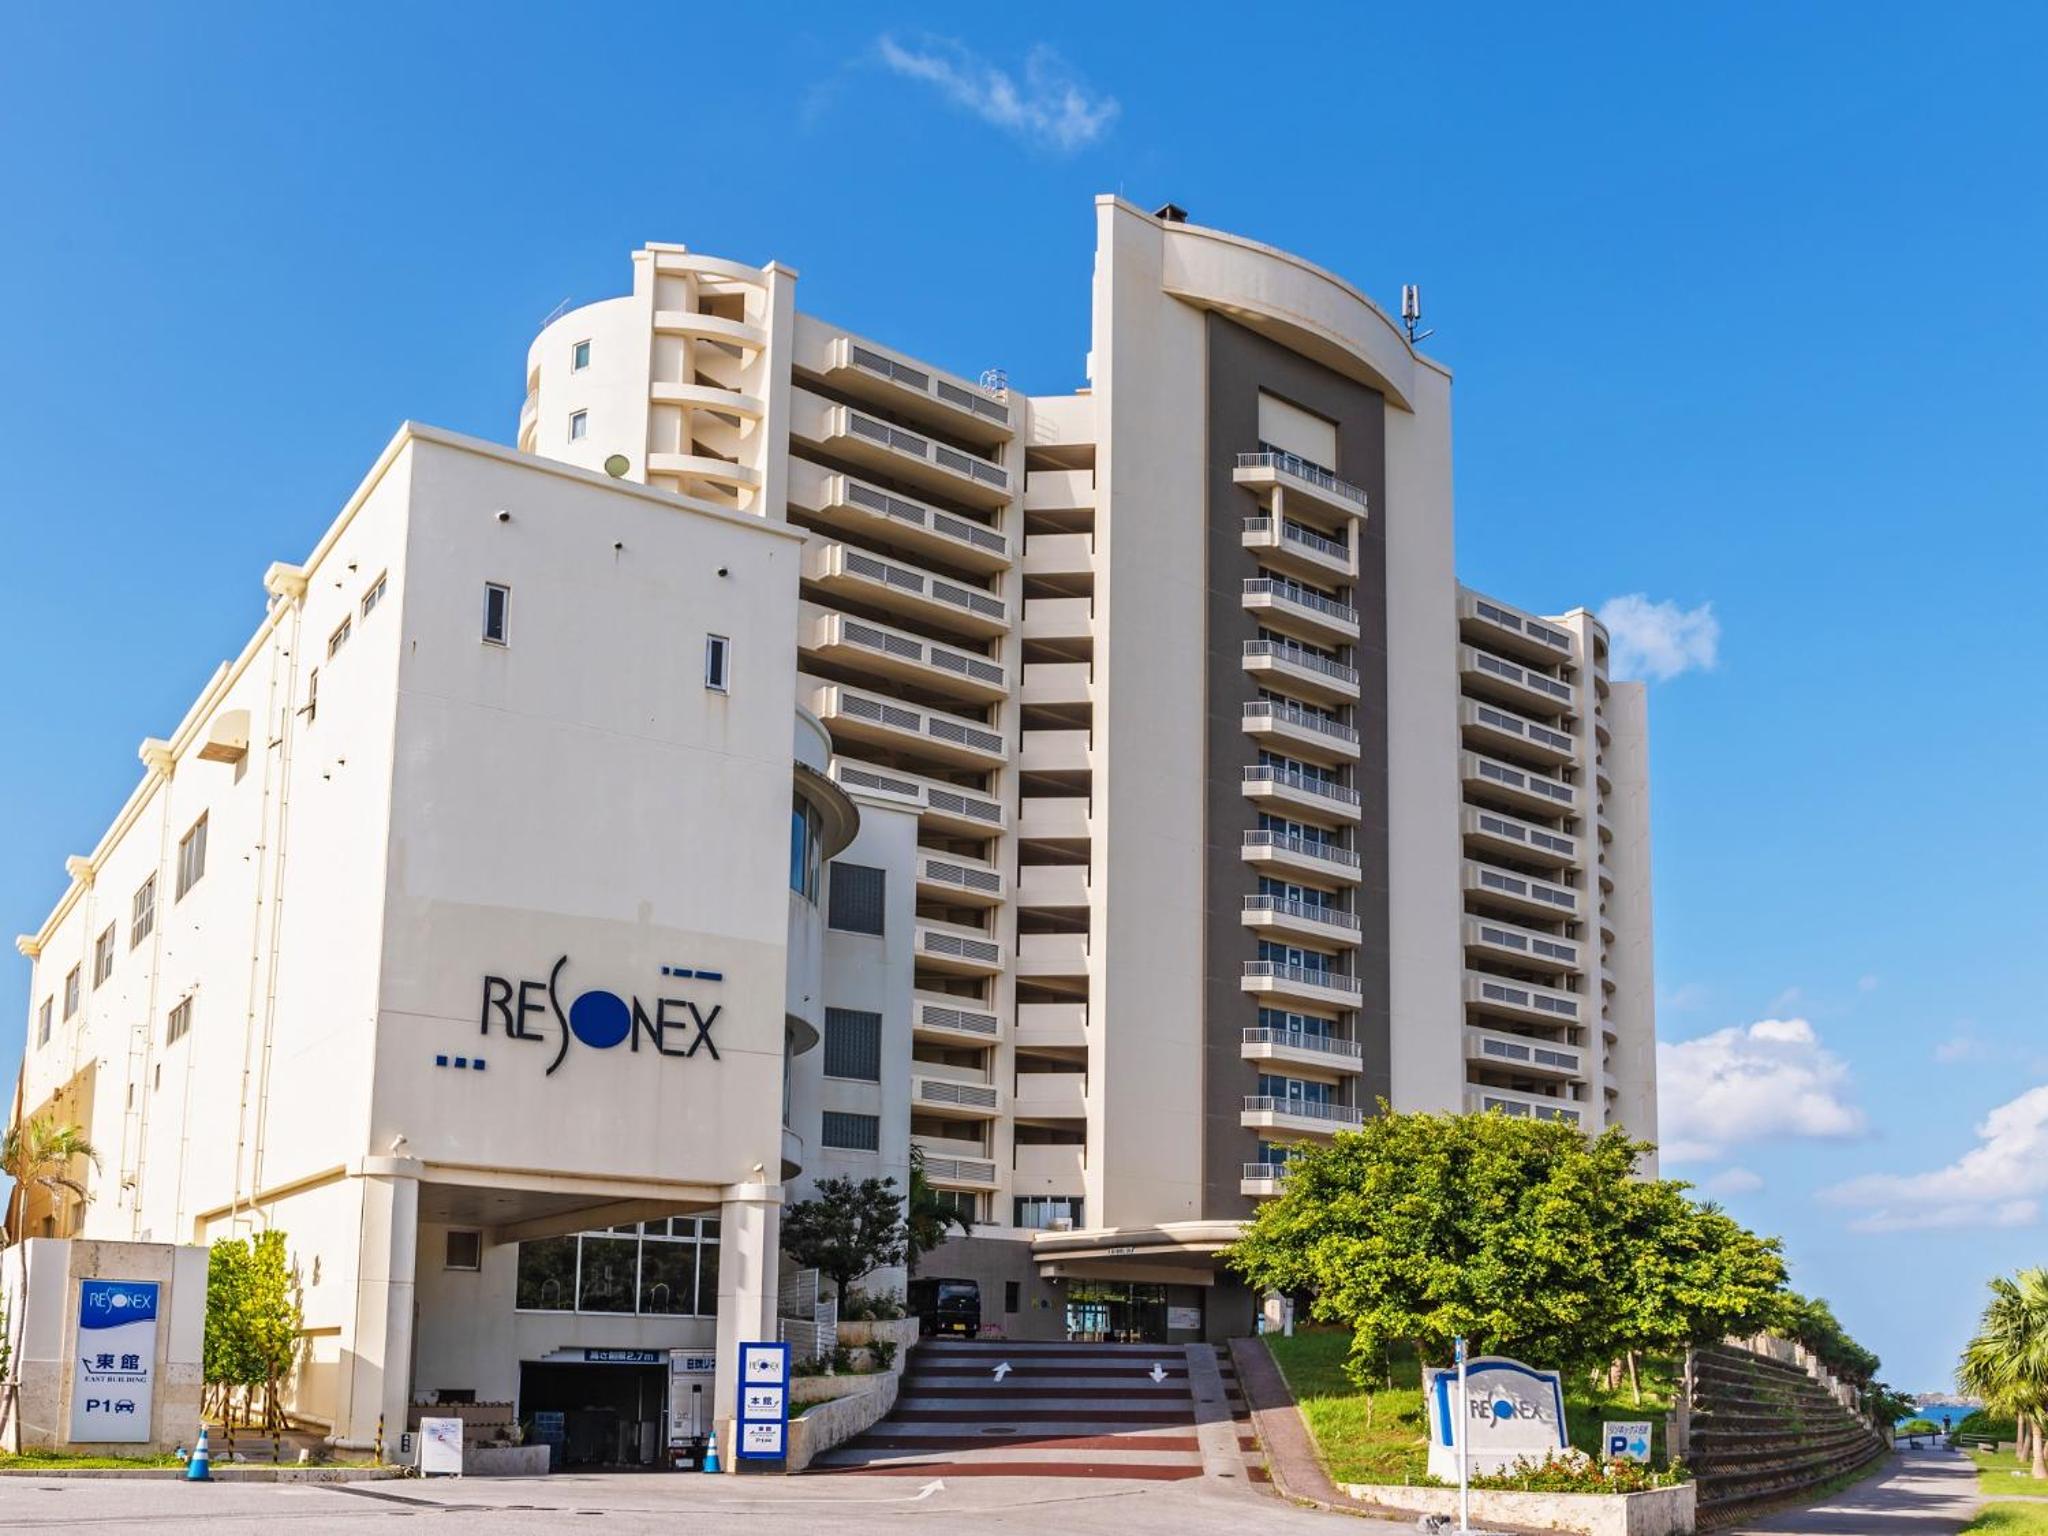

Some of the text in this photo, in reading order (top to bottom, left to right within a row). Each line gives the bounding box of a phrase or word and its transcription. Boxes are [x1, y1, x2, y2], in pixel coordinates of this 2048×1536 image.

[480, 955, 722, 1077] RESONEX
[90, 1287, 151, 1314] RESONEX
[96, 1353, 140, 1370] 東館
[86, 1399, 111, 1412] P1
[1610, 1436, 1627, 1455] P
